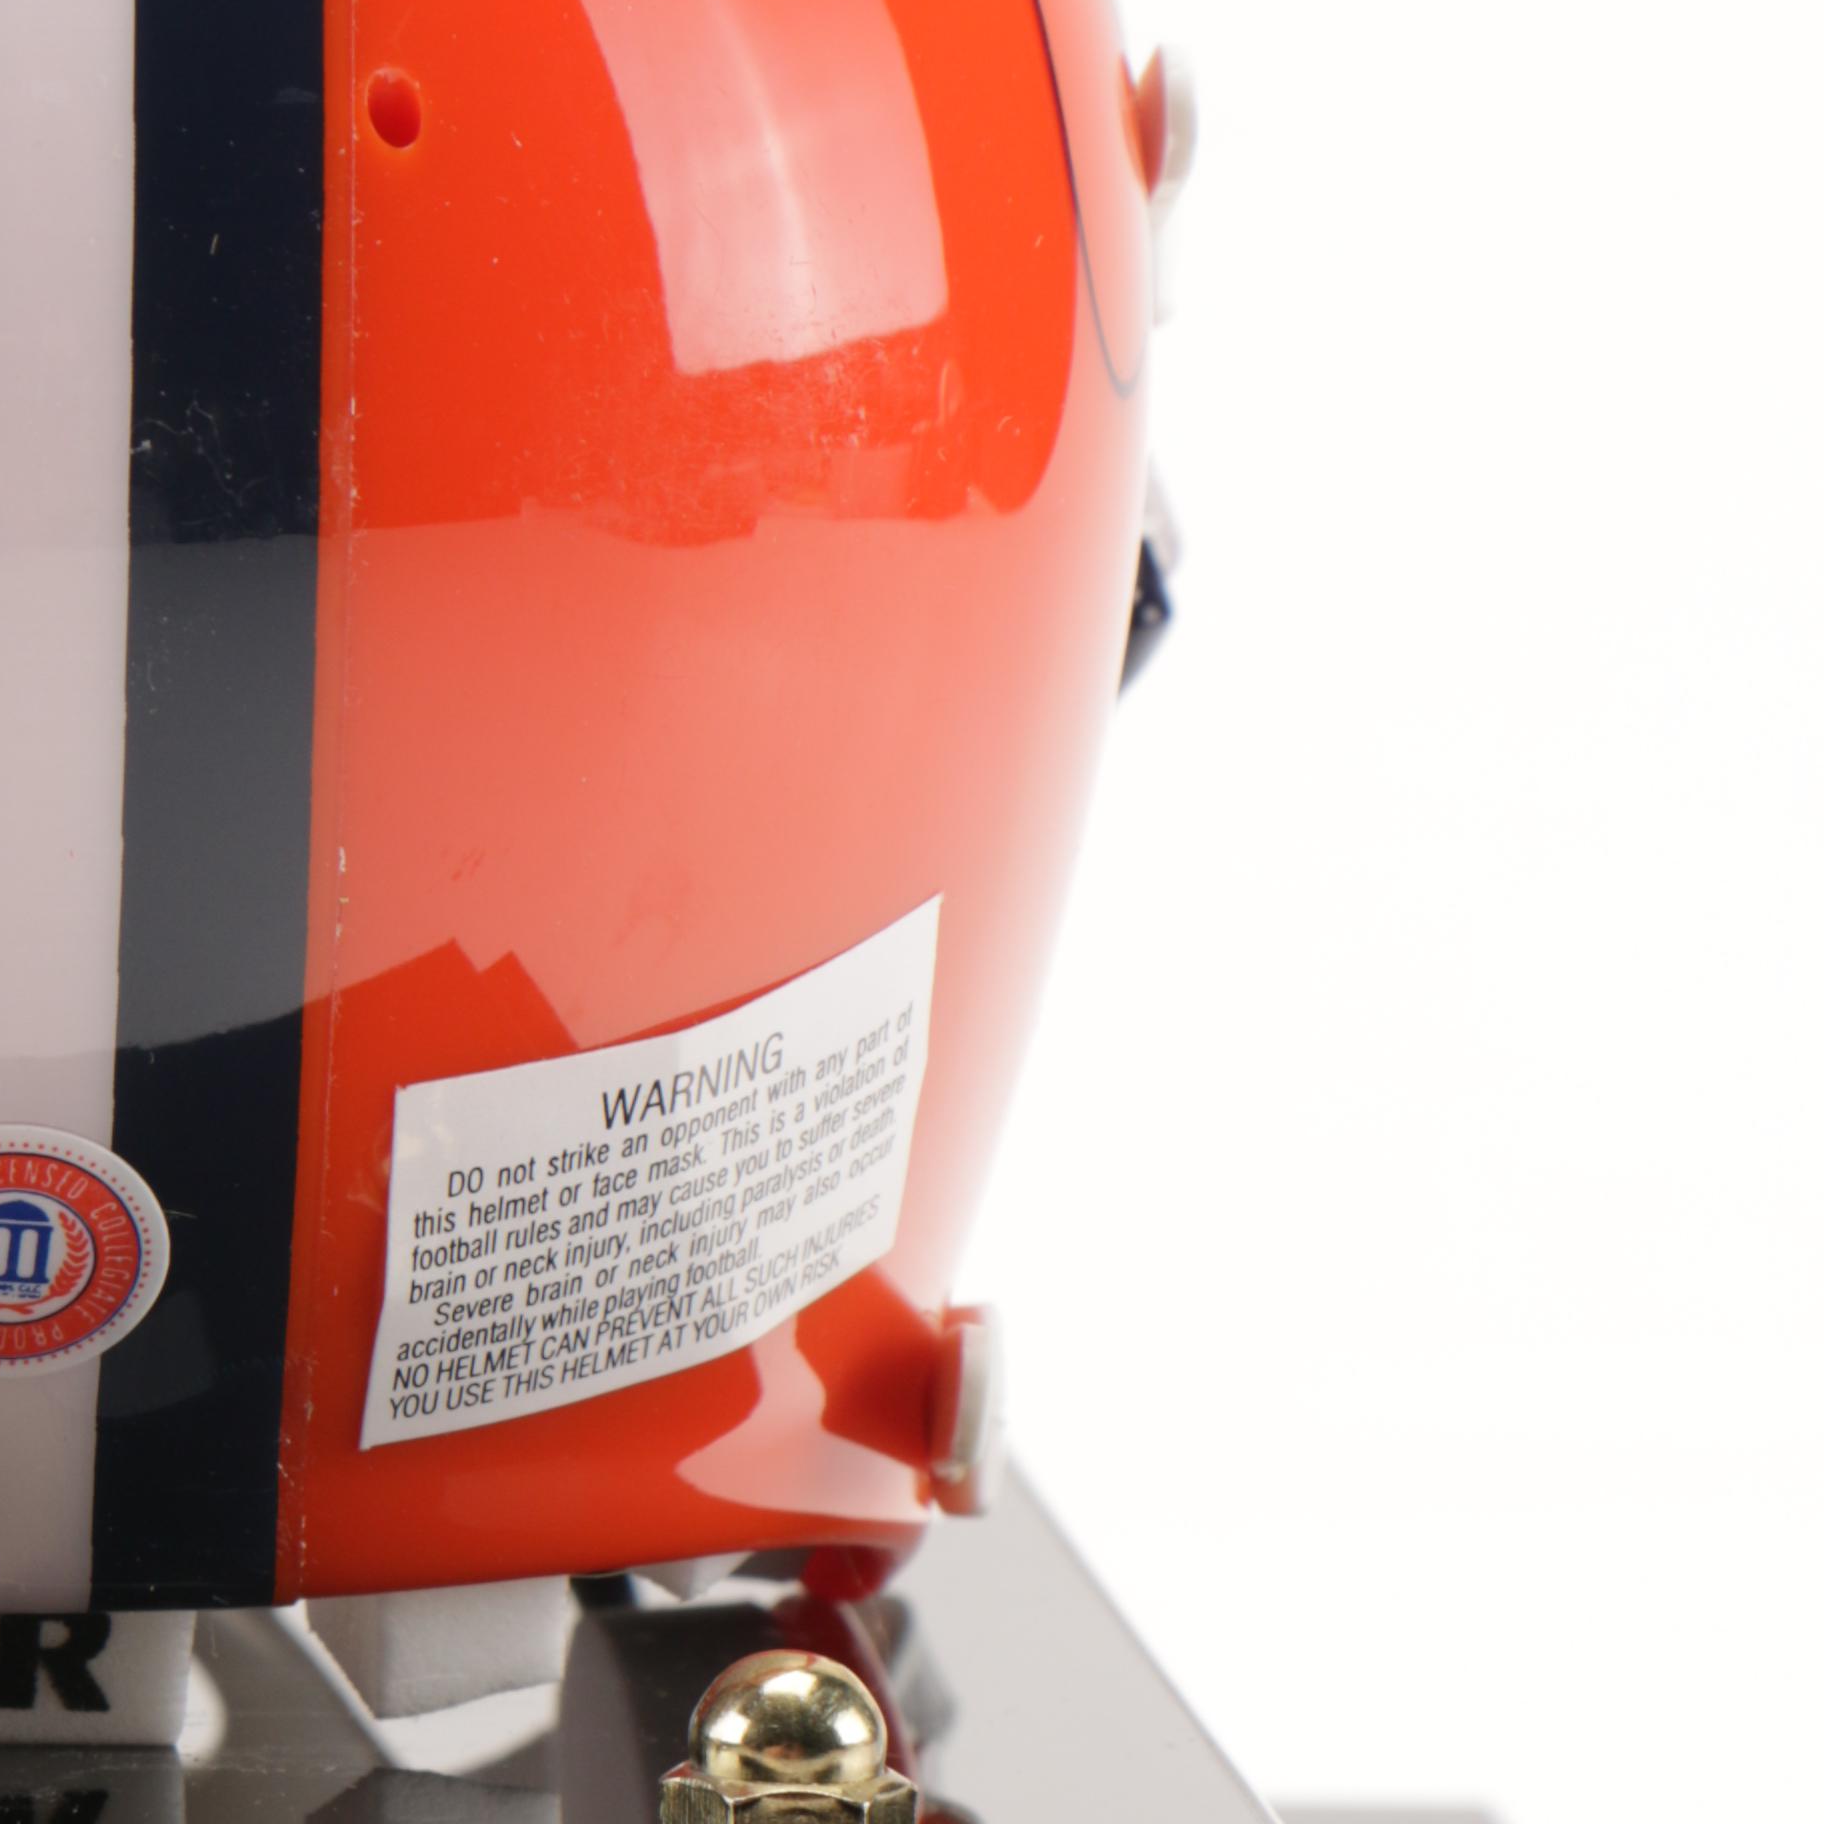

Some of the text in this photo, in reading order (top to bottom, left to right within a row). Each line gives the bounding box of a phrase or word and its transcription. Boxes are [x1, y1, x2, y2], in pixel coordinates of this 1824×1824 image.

[412, 1074, 906, 1272] football rules and may cause you to suffer severe
[414, 1036, 910, 1239] this helmet or face mask. This is a violation of
[448, 1000, 914, 1198] DO not strike an opponent with any part of
[601, 1032, 784, 1130] WARNING
[79, 1202, 133, 1324] COLLEGIATE
[393, 1194, 881, 1391] NO HELMET CAN PREVENT ALL SUCH INJURIES
[397, 1237, 762, 1362] accidentally while playing football.
[409, 1106, 896, 1304] brain or neck injury, including paralysis or death.
[434, 1133, 896, 1326] Severe brain or neck injury may also occur
[389, 1247, 841, 1420] YOU USE THIS HELMET AT YOUR OWN RISK
